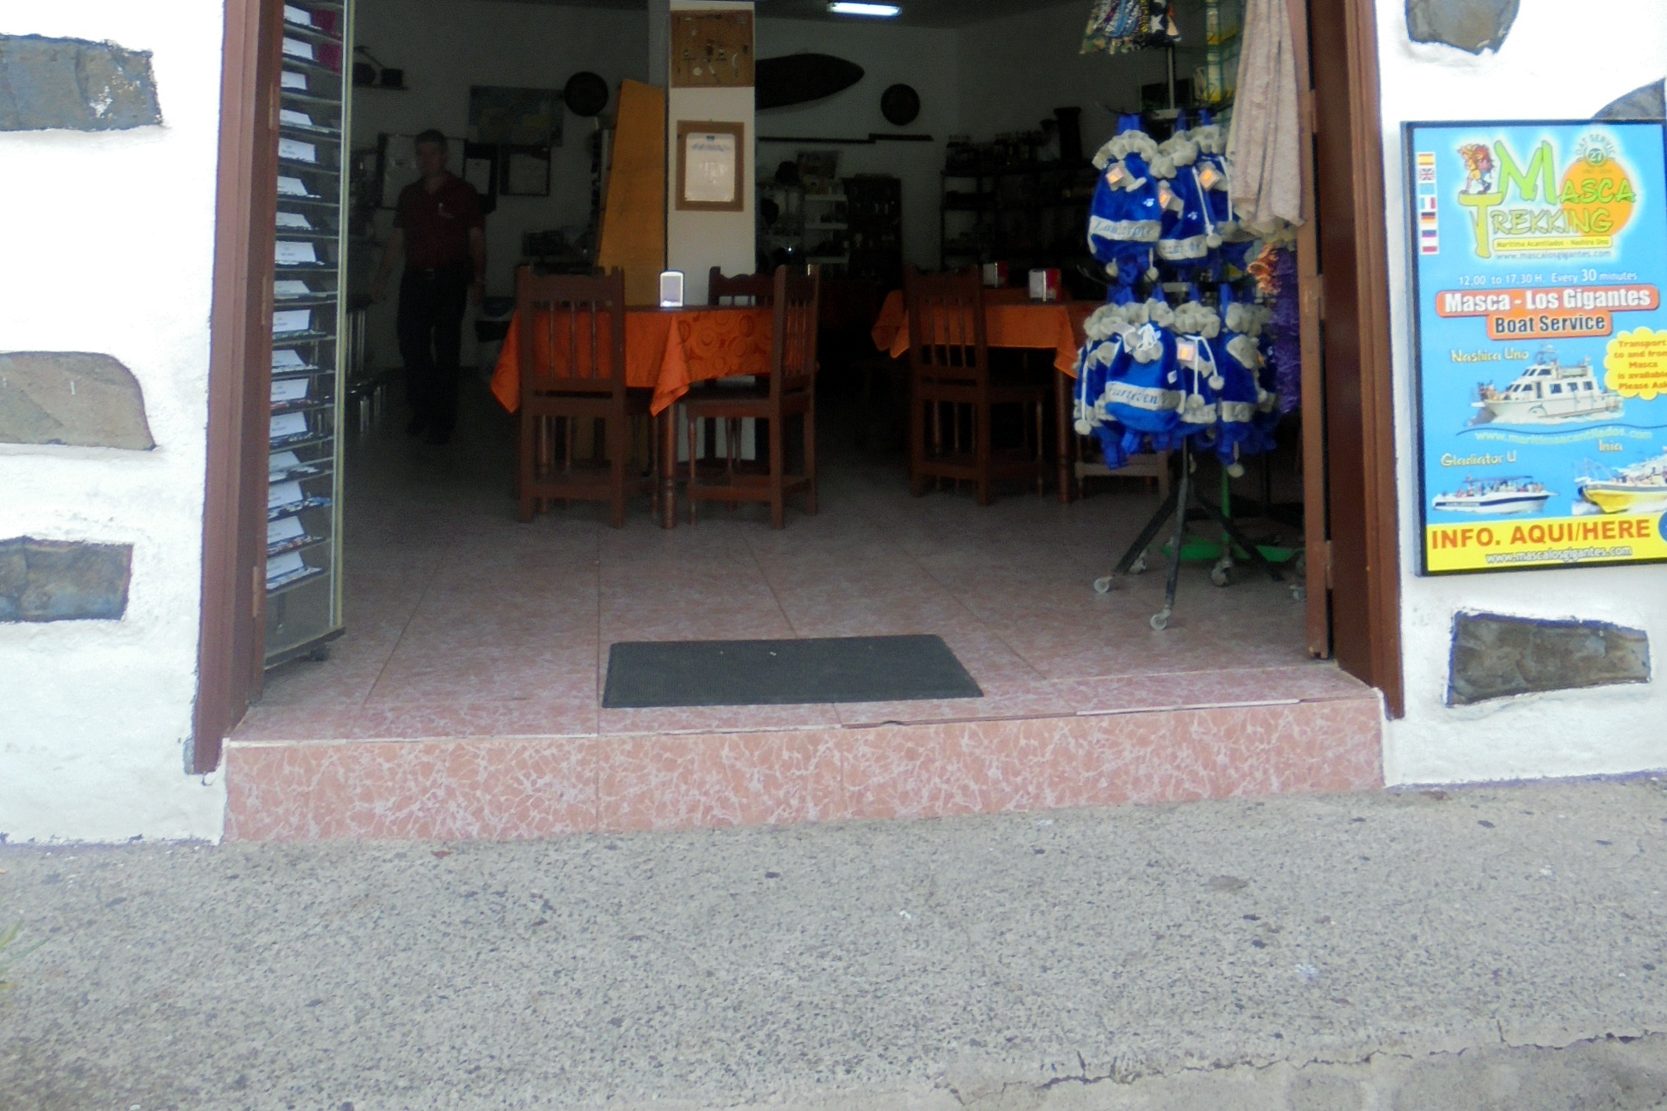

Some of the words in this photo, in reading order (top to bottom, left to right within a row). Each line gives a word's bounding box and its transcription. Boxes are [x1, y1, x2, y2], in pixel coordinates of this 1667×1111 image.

[1493, 139, 1637, 206] MASCA
[1457, 191, 1615, 259] TREKKING
[1491, 276, 1502, 285] to
[1551, 273, 1578, 285] Every
[1581, 268, 1597, 282] 30
[1444, 292, 1511, 313] Masca
[1525, 290, 1560, 310] Los
[1563, 288, 1652, 310] Gigantes
[1495, 316, 1535, 334] Boat
[1538, 314, 1606, 332] Service
[1618, 339, 1667, 350] Transport
[1450, 349, 1501, 364] Nashira
[1504, 347, 1529, 361] Uno
[1440, 452, 1504, 468] Gladiator
[1506, 450, 1517, 464] U
[1431, 527, 1502, 550] INFO.
[1509, 518, 1652, 546] AQUI/HERE
[1485, 545, 1634, 565] www.mascalosgigantes.com
